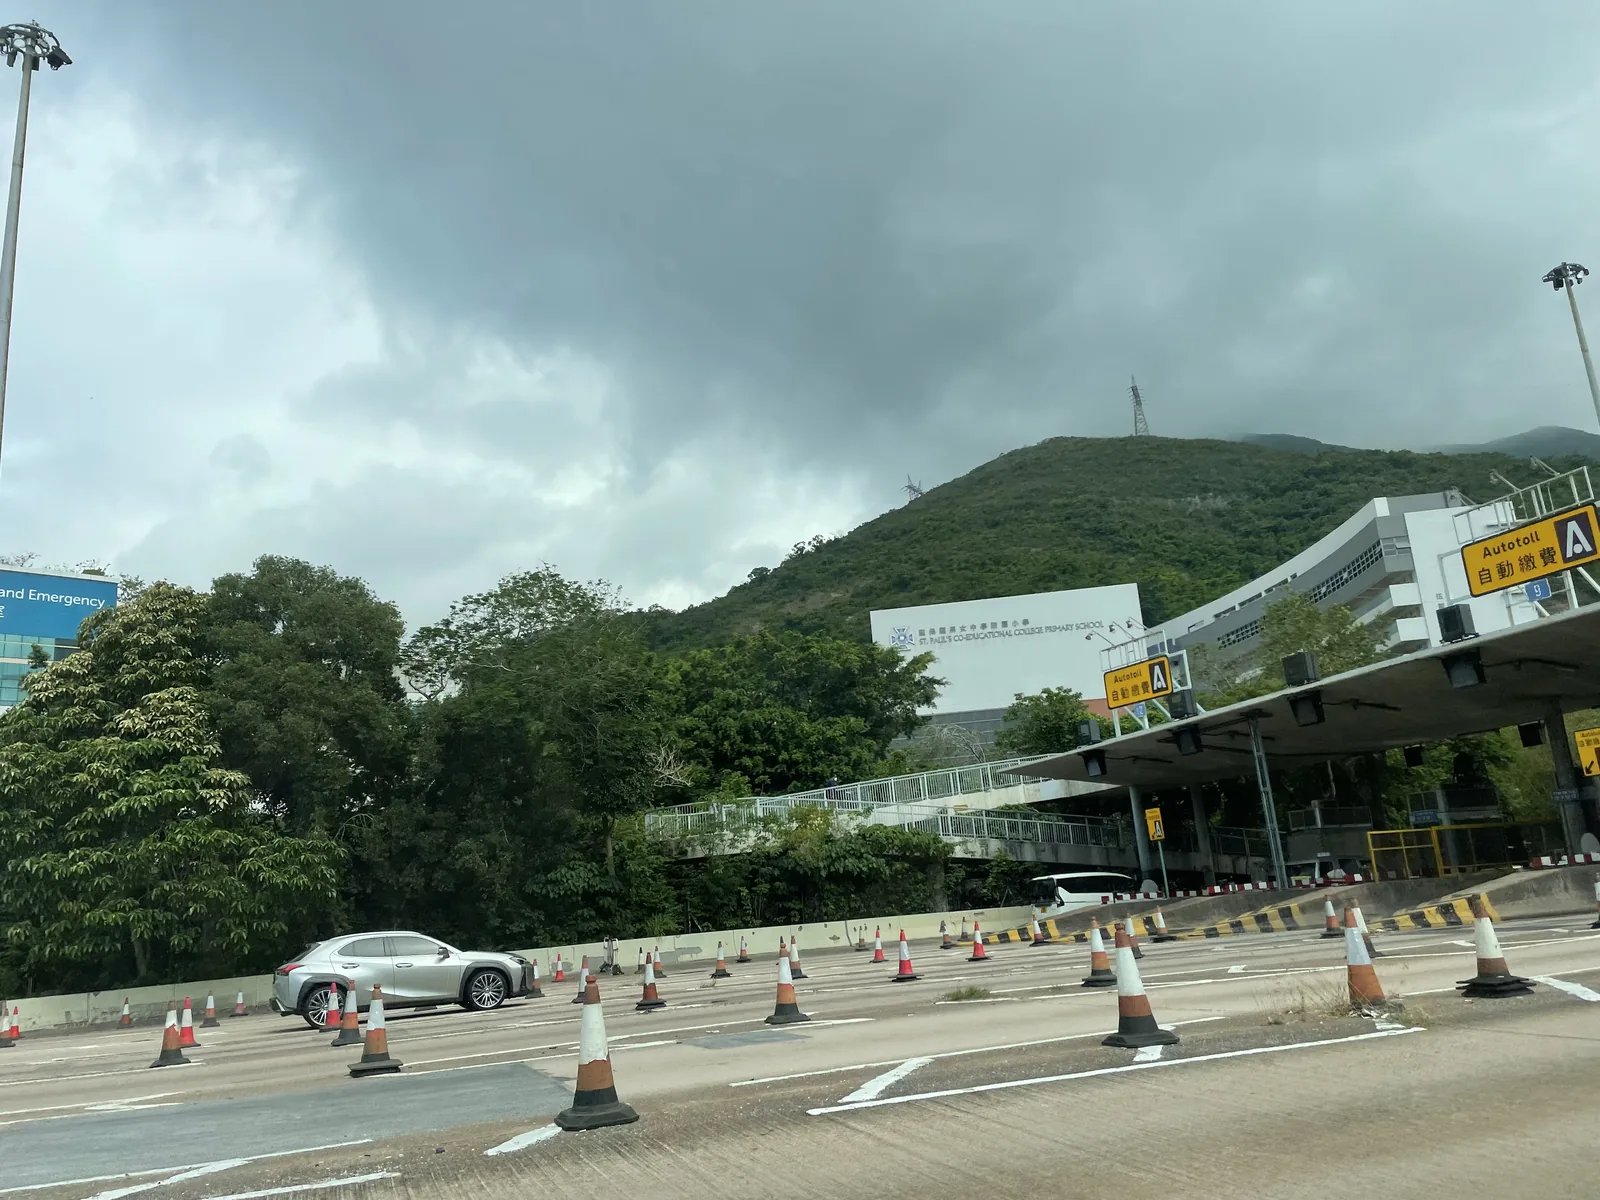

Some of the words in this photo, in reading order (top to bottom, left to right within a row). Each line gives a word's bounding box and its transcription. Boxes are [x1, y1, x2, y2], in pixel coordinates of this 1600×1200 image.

[1482, 530, 1541, 560] Autotoll
[1478, 546, 1558, 586] 自動繳費
[0, 588, 24, 599] and
[28, 589, 105, 609] Emergency
[1533, 584, 1542, 597] 9
[930, 635, 952, 645] PAUL'S
[953, 629, 1013, 643] CO-EDUCATIONAL
[1013, 626, 1044, 637] COLLEGE
[1045, 623, 1074, 634] PRIMARY
[1075, 620, 1104, 631] SCHOOL
[1113, 669, 1142, 684] Autotoll
